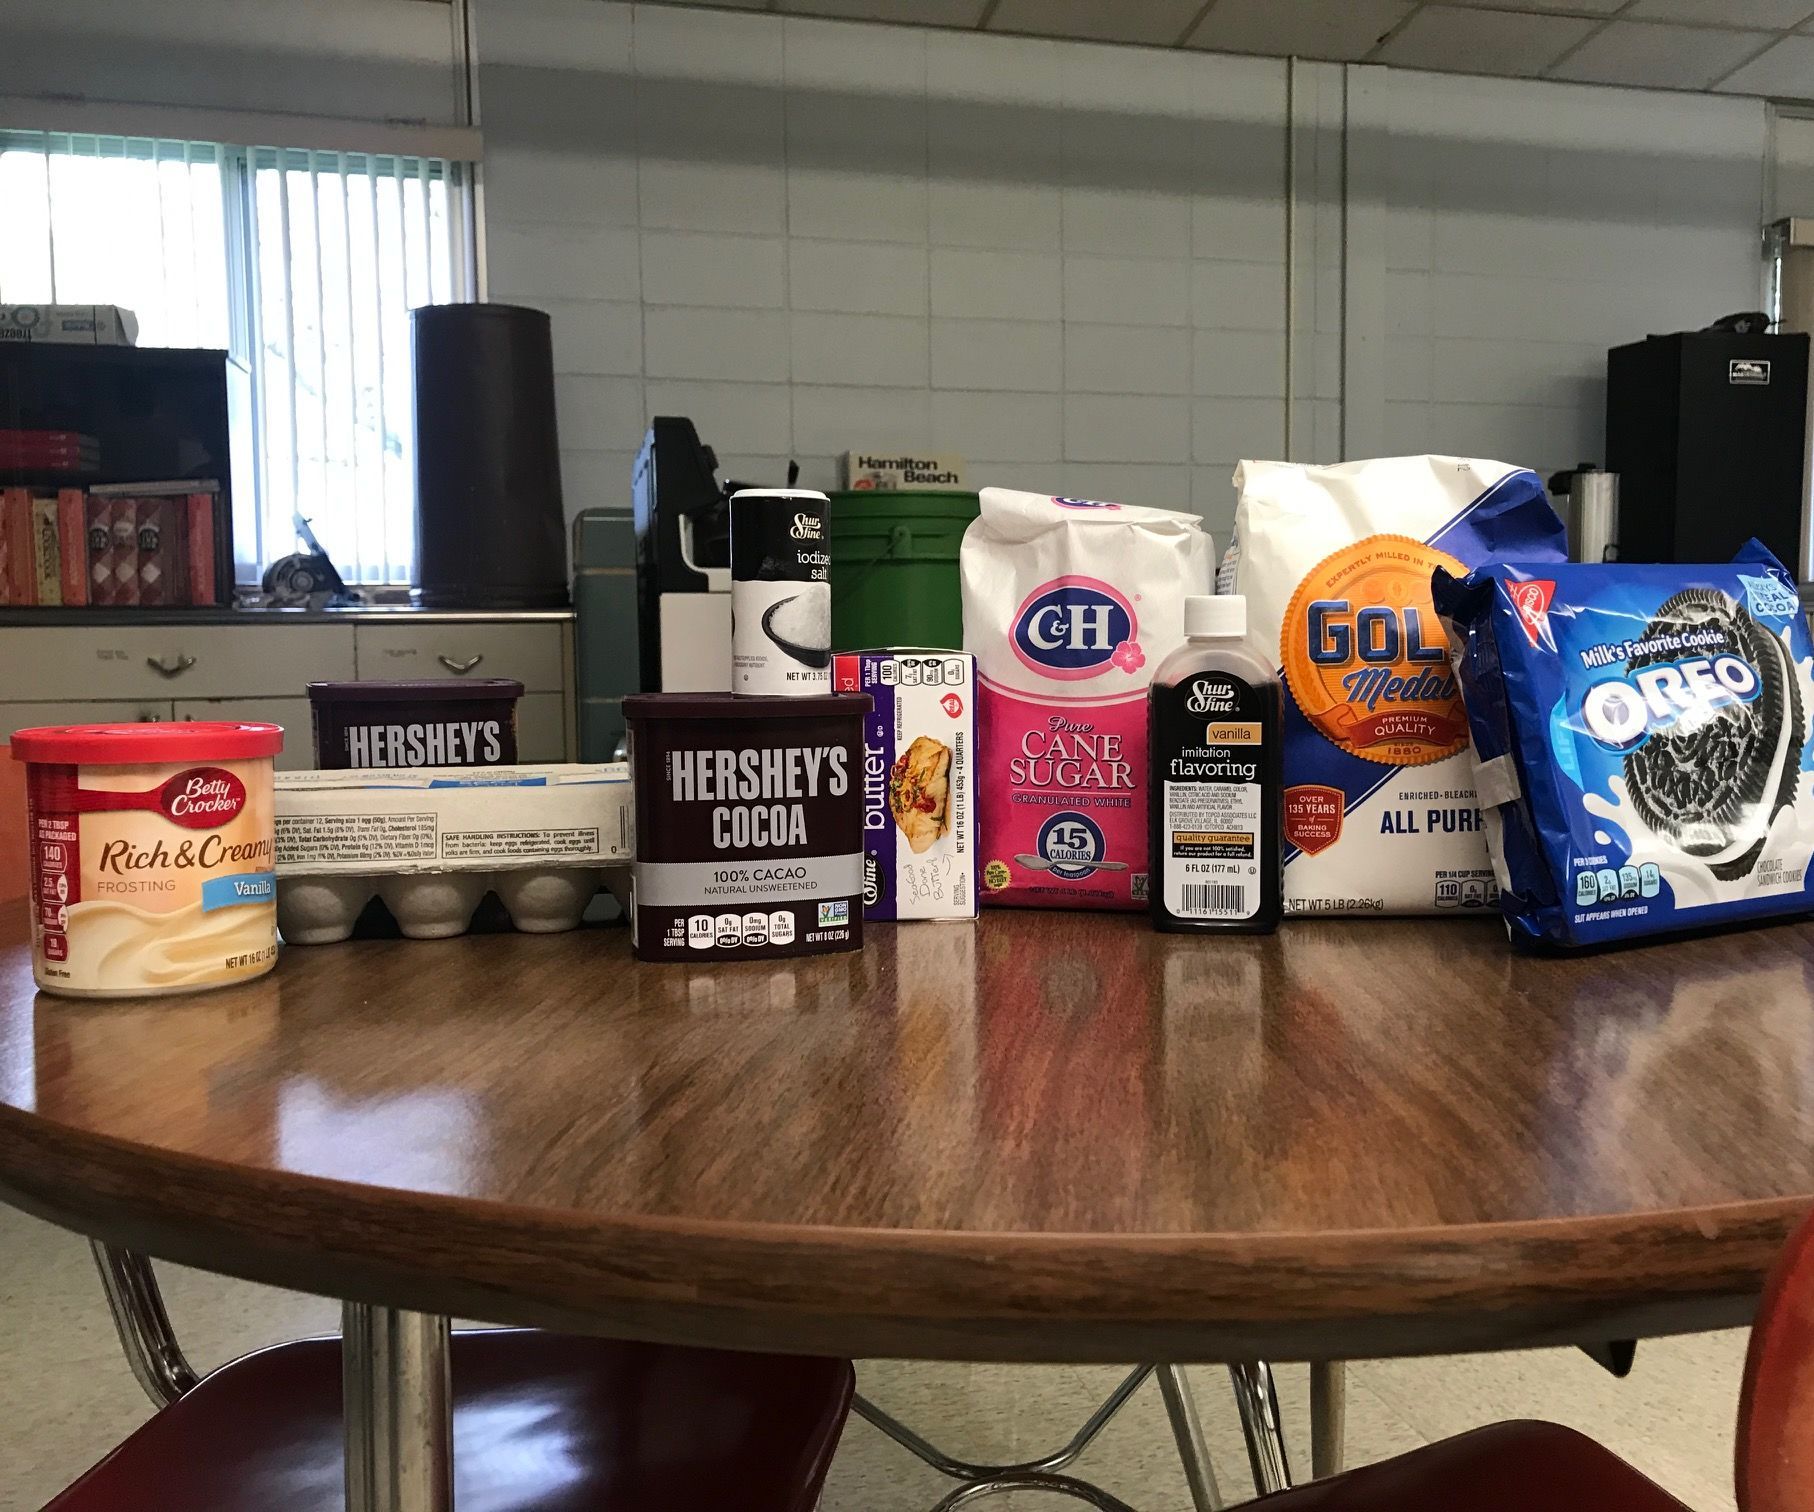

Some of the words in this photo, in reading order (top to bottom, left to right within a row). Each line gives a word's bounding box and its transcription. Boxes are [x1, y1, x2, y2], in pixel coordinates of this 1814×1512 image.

[858, 456, 938, 470] Hamilton
[904, 470, 958, 484] Beach
[811, 567, 828, 580] salt
[1325, 554, 1372, 589] EXPERTLY
[1376, 552, 1411, 562] MILLED
[1413, 557, 1424, 567] IN
[1028, 605, 1114, 650] C&H
[1307, 599, 1445, 666] GOL
[1580, 645, 1625, 669] Milk's
[1624, 632, 1682, 658] Favorite
[1681, 629, 1725, 648] Cookie
[787, 672, 799, 680] NET
[801, 672, 811, 680] WT
[882, 664, 892, 681] 100
[1342, 666, 1455, 713] Medal
[1584, 656, 1757, 746] OREO
[1048, 716, 1094, 733] Pure
[1382, 714, 1428, 724] PREMIUM
[1212, 728, 1251, 740] vanilla
[1374, 724, 1437, 737] QUALITY
[349, 720, 501, 768] HERSHEY'S
[955, 731, 964, 764] QUARTERS
[1021, 730, 1123, 762] CANE
[1388, 746, 1421, 755] 1880
[1182, 747, 1231, 758] imitation
[672, 746, 848, 801] HERSHEY'S
[1010, 757, 1136, 789] SUGAR
[1170, 758, 1257, 781] flavoring
[186, 777, 231, 799] Betty
[864, 742, 885, 830] butter
[956, 775, 965, 790] 453g
[956, 792, 965, 803] LB)
[1012, 793, 1090, 807] GRANULATED
[1094, 798, 1131, 808] WHITE
[1399, 791, 1439, 800] ENRICHED
[171, 796, 239, 816] Crocker
[1288, 804, 1304, 814] 135
[1306, 804, 1336, 814] YEARS
[956, 810, 965, 820] OZ
[1308, 815, 1316, 823] of
[1380, 810, 1420, 834] ALL
[713, 803, 808, 849] COCOA
[956, 821, 965, 829] 16
[45, 831, 77, 841] PACKAGED
[956, 830, 965, 841] WT
[1052, 828, 1088, 850] 15
[1176, 834, 1206, 842] quality
[44, 846, 61, 861] 140
[99, 840, 171, 875] Rich
[199, 834, 273, 869] Creamy
[956, 842, 965, 854] NET
[1050, 849, 1091, 861] CALORIES
[1053, 866, 1063, 877] per
[1063, 868, 1091, 879] teaspoon
[1185, 864, 1190, 872] 6
[1191, 864, 1199, 872] FL
[1201, 864, 1210, 873] OZ
[1212, 864, 1225, 874] (177
[1227, 864, 1240, 874] mL)
[1757, 858, 1783, 873] CHOCOLATE
[713, 869, 750, 883] 100%
[753, 866, 807, 881] CACAO
[1435, 870, 1447, 878] PER
[1458, 870, 1470, 878] CUP
[97, 879, 177, 893] FROSTING
[234, 880, 271, 896] Vanilla
[704, 885, 747, 895] NATURAL
[749, 881, 818, 893] UNSWEETENED
[1579, 875, 1595, 889] 160
[1440, 884, 1457, 895] 110
[1289, 898, 1307, 911] NET
[1308, 899, 1323, 911] WT
[1324, 899, 1331, 910] 5
[1333, 899, 1345, 910] LB
[1346, 897, 1384, 911] (2.26kg)
[749, 916, 762, 925] 0mg
[778, 915, 786, 924] 0g
[1585, 911, 1610, 922] APPEARS
[1610, 908, 1627, 919] WHEN
[1627, 905, 1649, 917] OPENED
[674, 918, 685, 928] PER
[694, 919, 708, 932] 10
[724, 918, 732, 927] 0g
[774, 923, 790, 931] TOTAL
[670, 929, 685, 937] TBSP
[771, 930, 793, 938] SUGARS
[806, 932, 814, 943] NET
[815, 932, 823, 942] WT
[663, 937, 685, 947] SERVING
[226, 957, 238, 969] NET
[240, 955, 247, 966] WT
[249, 953, 255, 964] 16
[59, 969, 70, 978] Free
